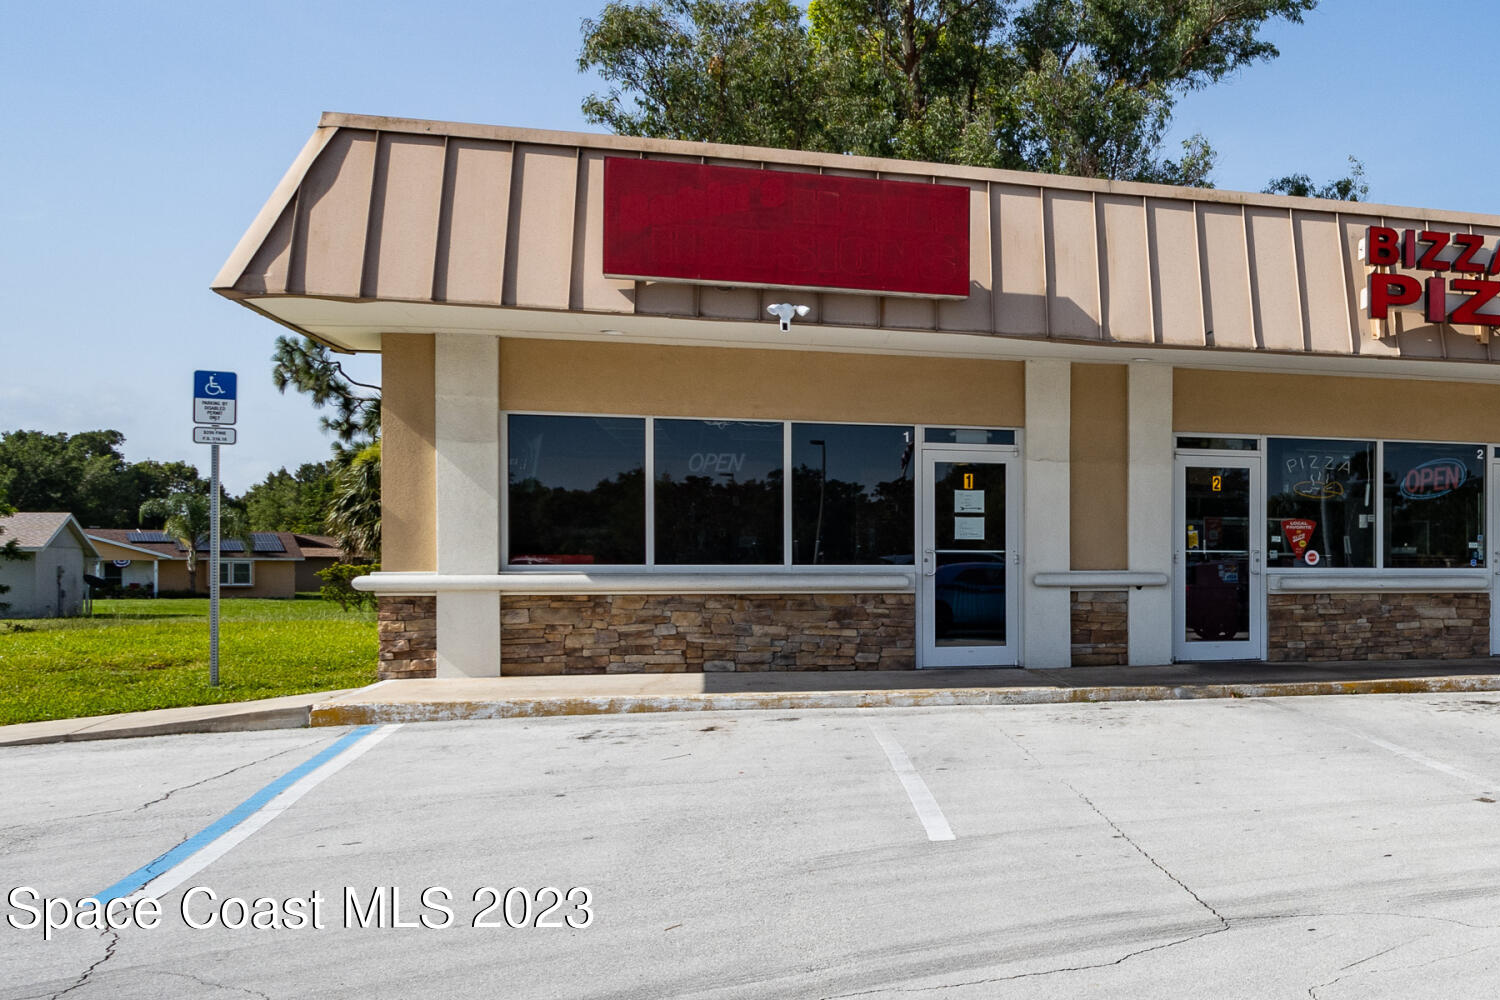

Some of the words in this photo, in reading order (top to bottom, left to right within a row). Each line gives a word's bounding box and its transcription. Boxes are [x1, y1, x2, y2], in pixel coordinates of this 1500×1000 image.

[903, 431, 910, 443] 1
[687, 452, 747, 473] OPEN
[1476, 449, 1484, 460] 2
[1286, 455, 1352, 476] PIZZA
[1405, 465, 1460, 494] OPEN
